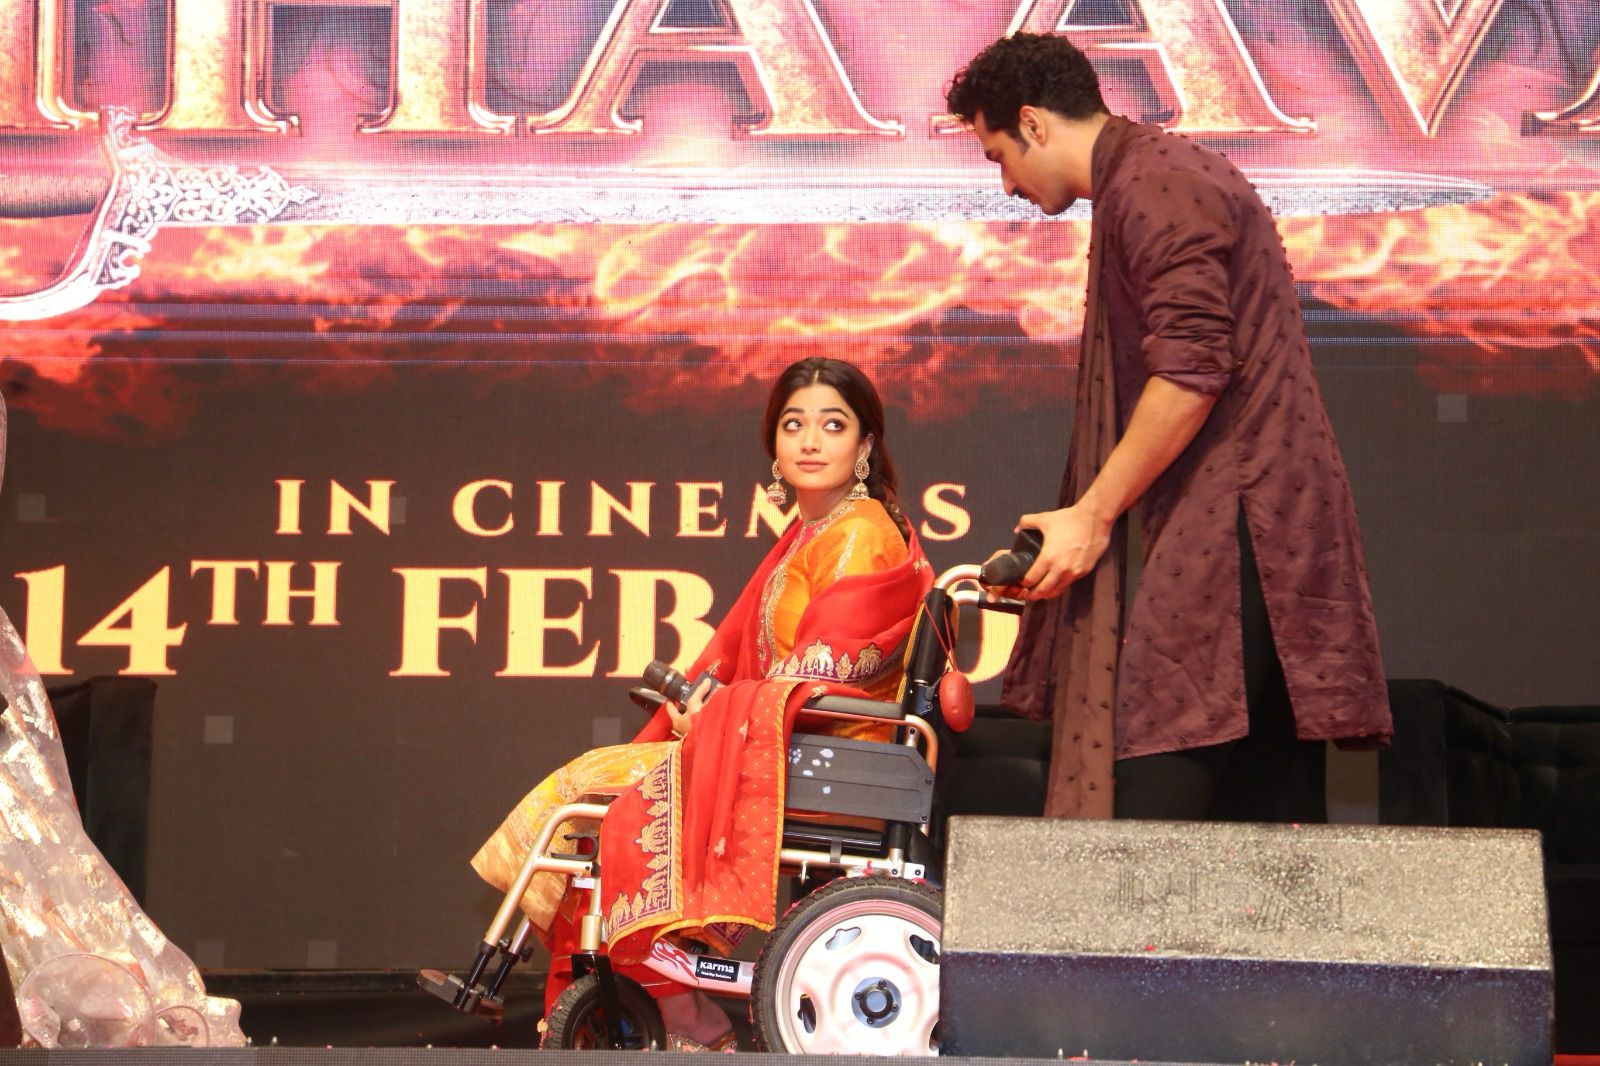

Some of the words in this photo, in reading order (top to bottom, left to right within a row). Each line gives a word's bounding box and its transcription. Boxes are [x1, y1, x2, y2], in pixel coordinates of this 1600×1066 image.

[275, 479, 396, 535] IN
[452, 479, 971, 541] CINEMS
[13, 560, 342, 676] 14TH
[388, 566, 716, 677] FEB
